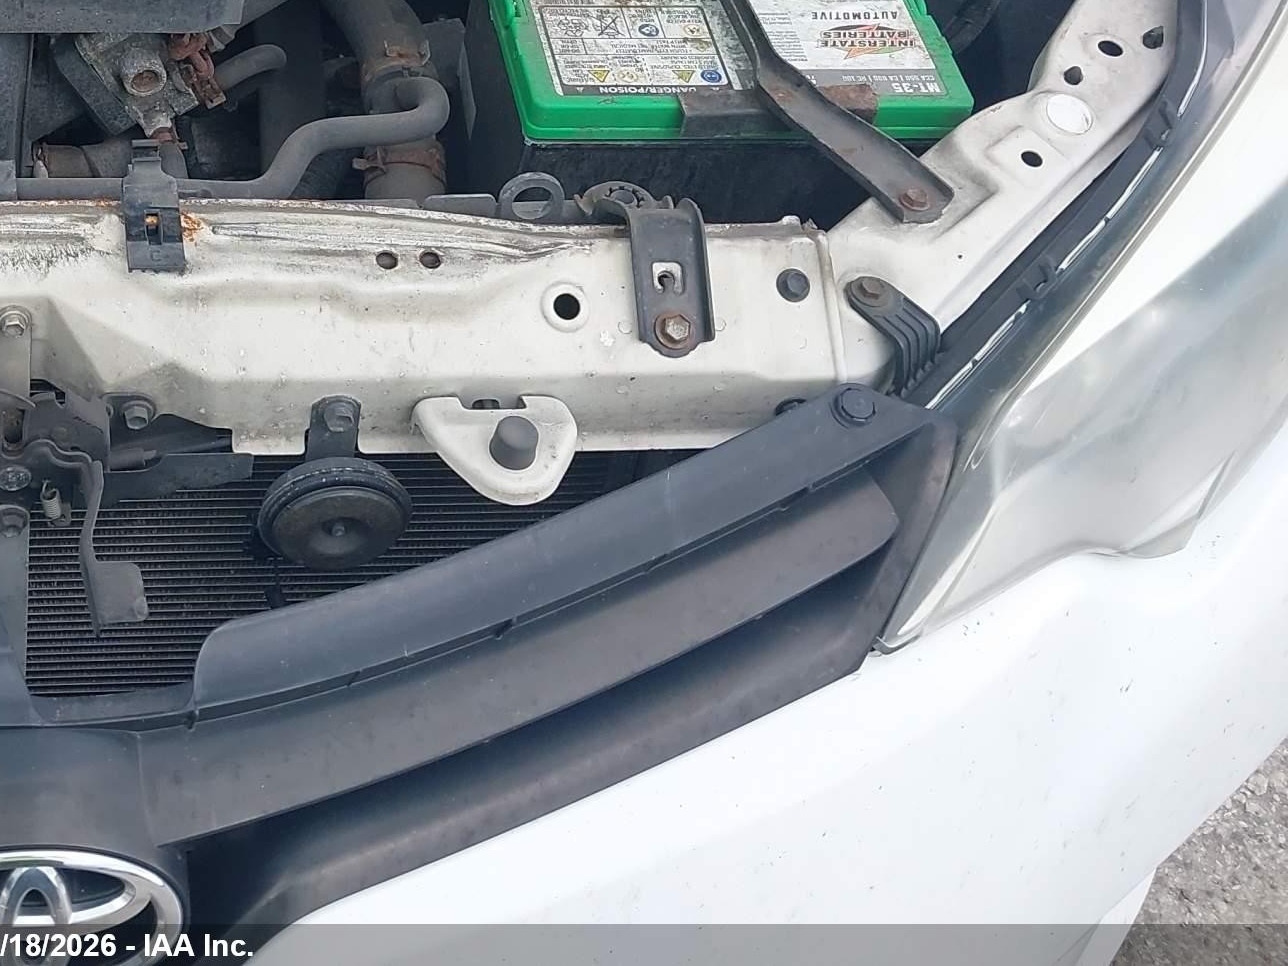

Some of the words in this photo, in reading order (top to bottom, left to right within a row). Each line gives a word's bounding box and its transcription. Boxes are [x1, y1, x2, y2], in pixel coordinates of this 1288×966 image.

[811, 11, 898, 20] AUTOMOTIVE
[820, 40, 914, 48] INTERSTATE
[892, 82, 941, 93] MT-35
